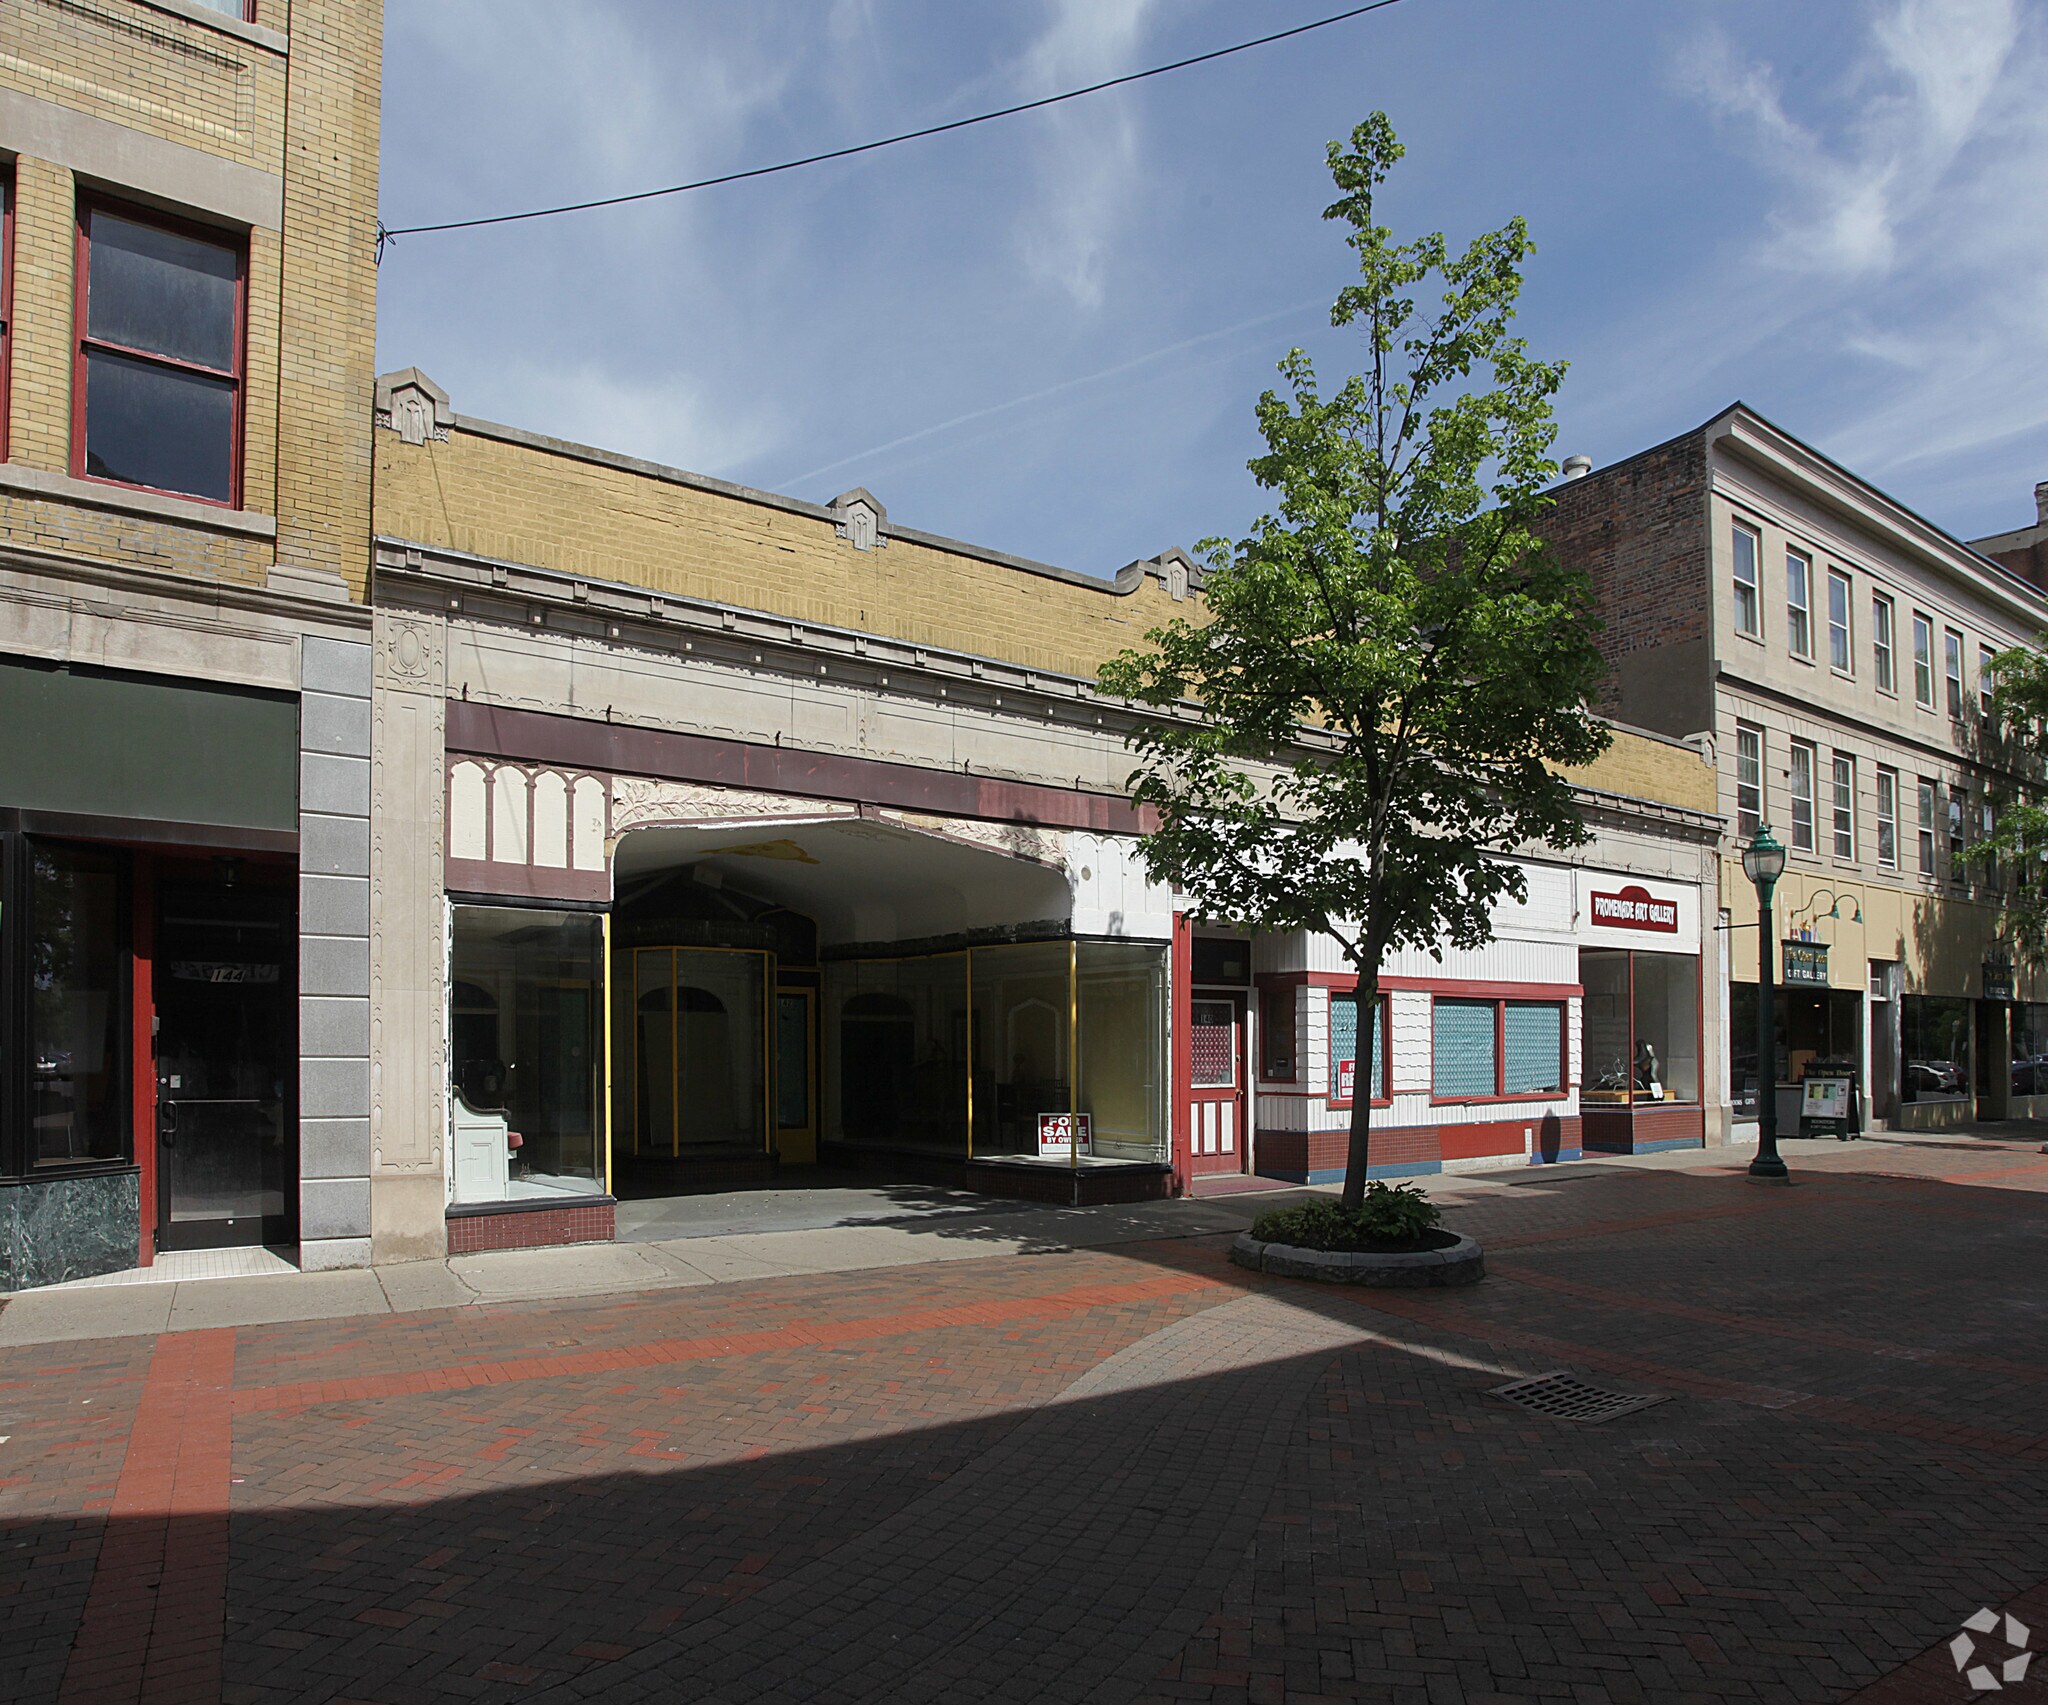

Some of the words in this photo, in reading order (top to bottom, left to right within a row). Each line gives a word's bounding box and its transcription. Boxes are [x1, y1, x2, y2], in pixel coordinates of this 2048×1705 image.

[1595, 897, 1634, 919] PROMENADE
[1635, 902, 1649, 922] ART
[1649, 904, 1675, 925] GALLERY
[214, 969, 244, 982] 144
[1802, 970, 1827, 980] GALLERY
[1341, 1072, 1355, 1087] RE
